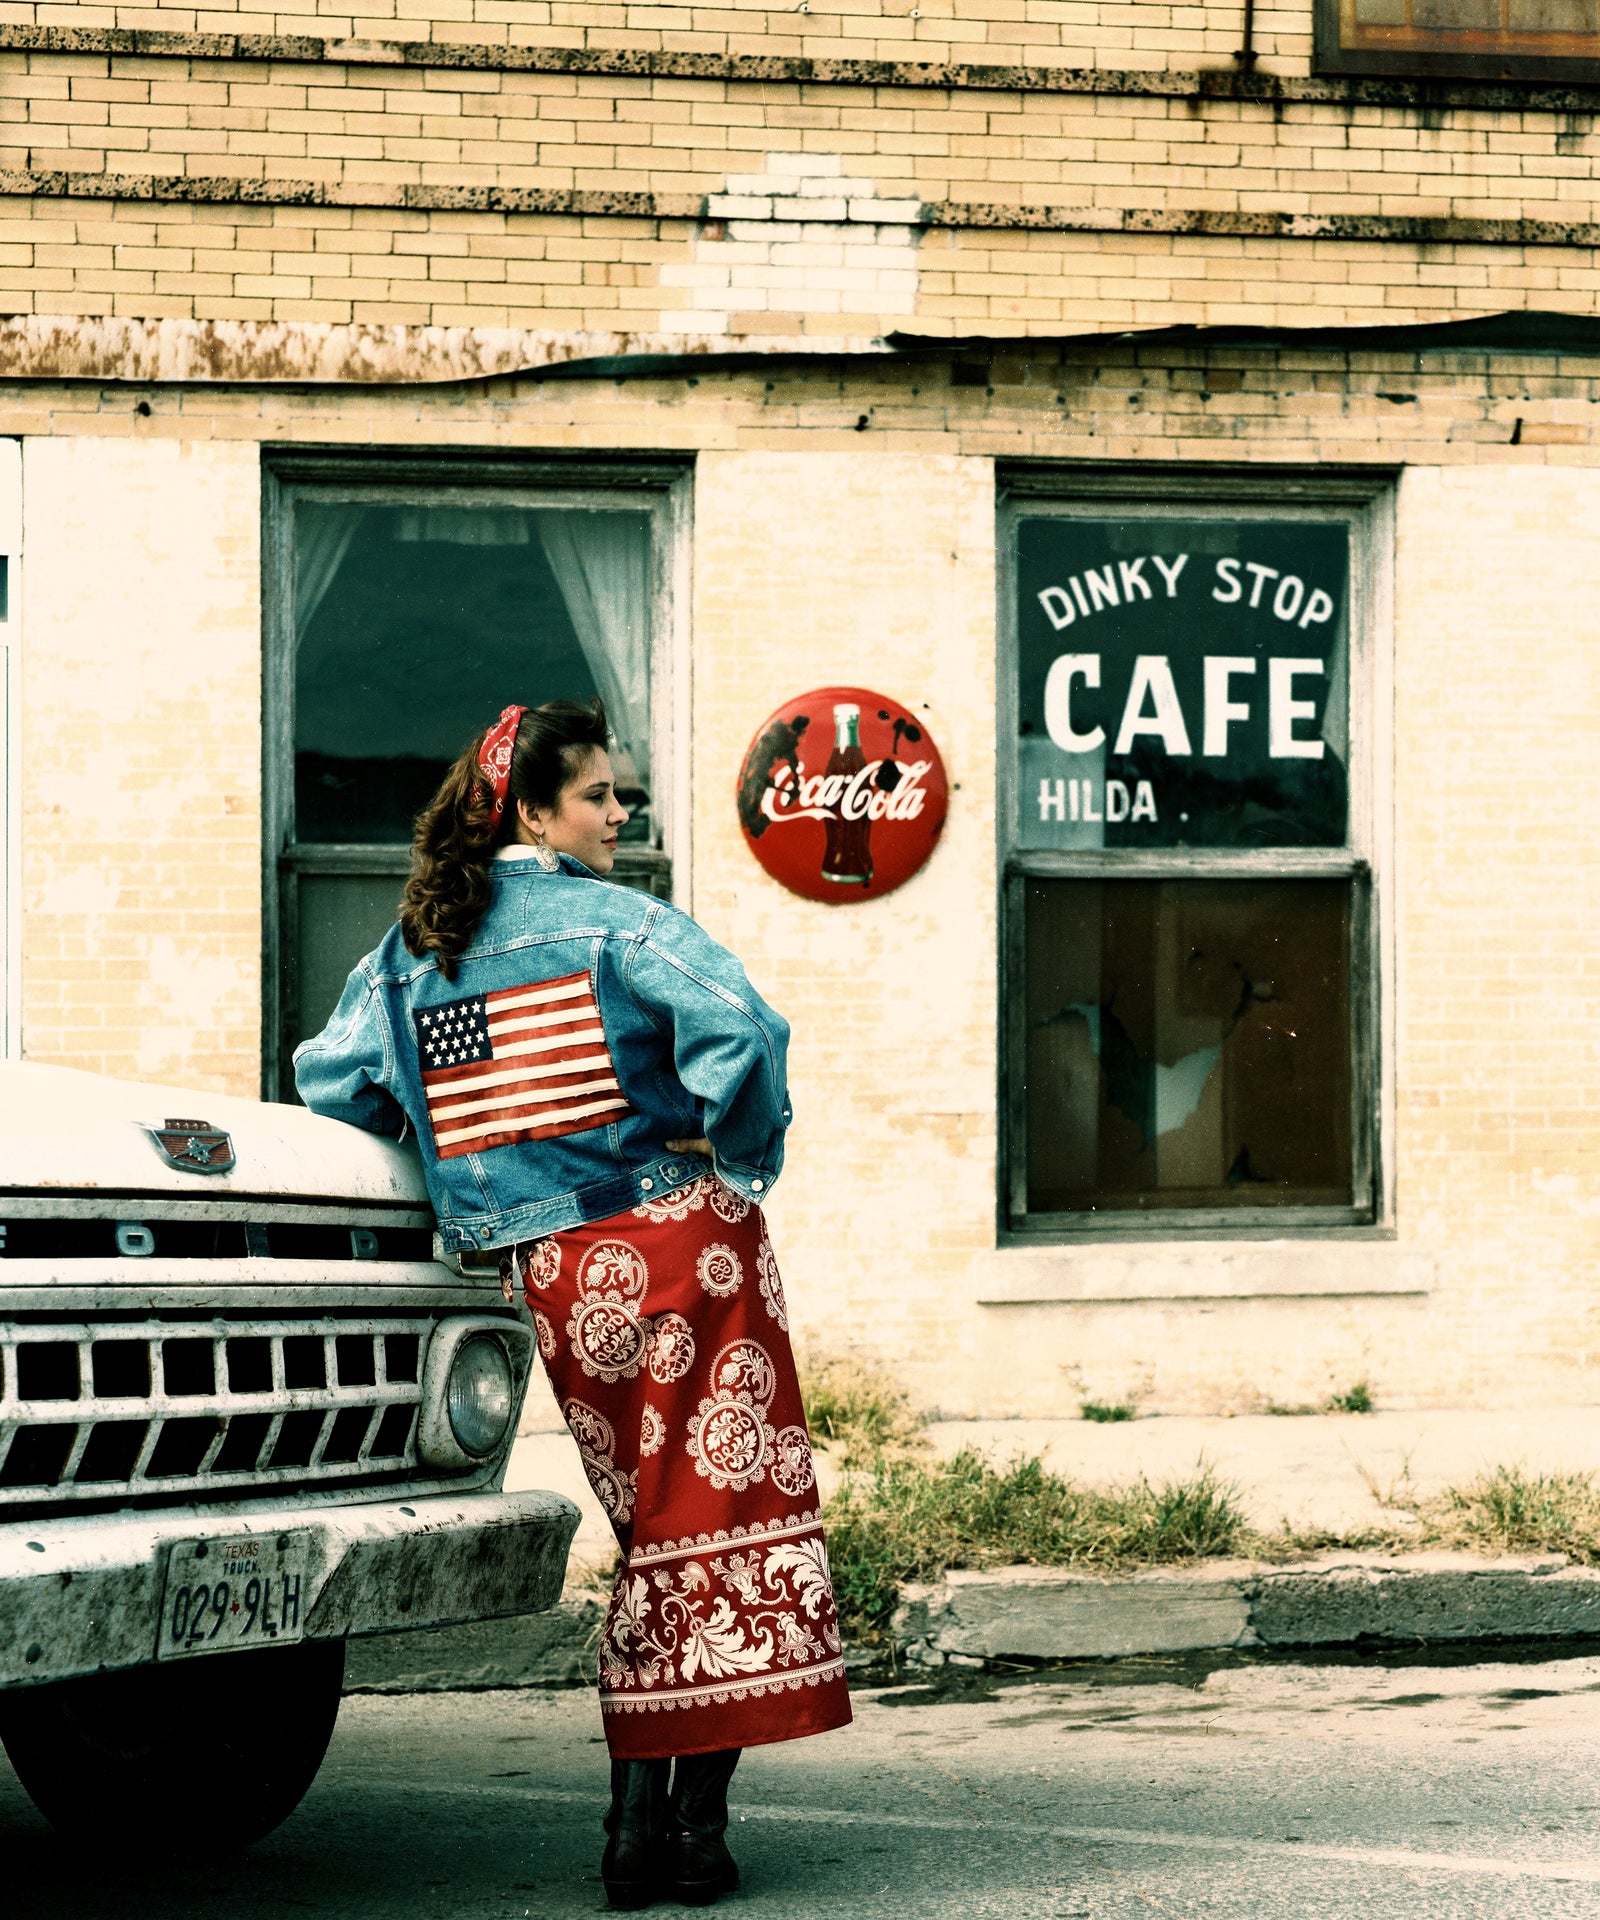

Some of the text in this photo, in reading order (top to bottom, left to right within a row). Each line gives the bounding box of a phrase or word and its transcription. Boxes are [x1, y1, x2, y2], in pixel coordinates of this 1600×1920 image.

[1037, 553, 1334, 631] DINKY STOP
[1044, 653, 1325, 760] CAFE
[1037, 778, 1159, 822] HILDA
[0, 1224, 380, 1259] OD
[224, 1540, 260, 1560] TEXAS
[171, 1573, 301, 1641] 029 9LH
